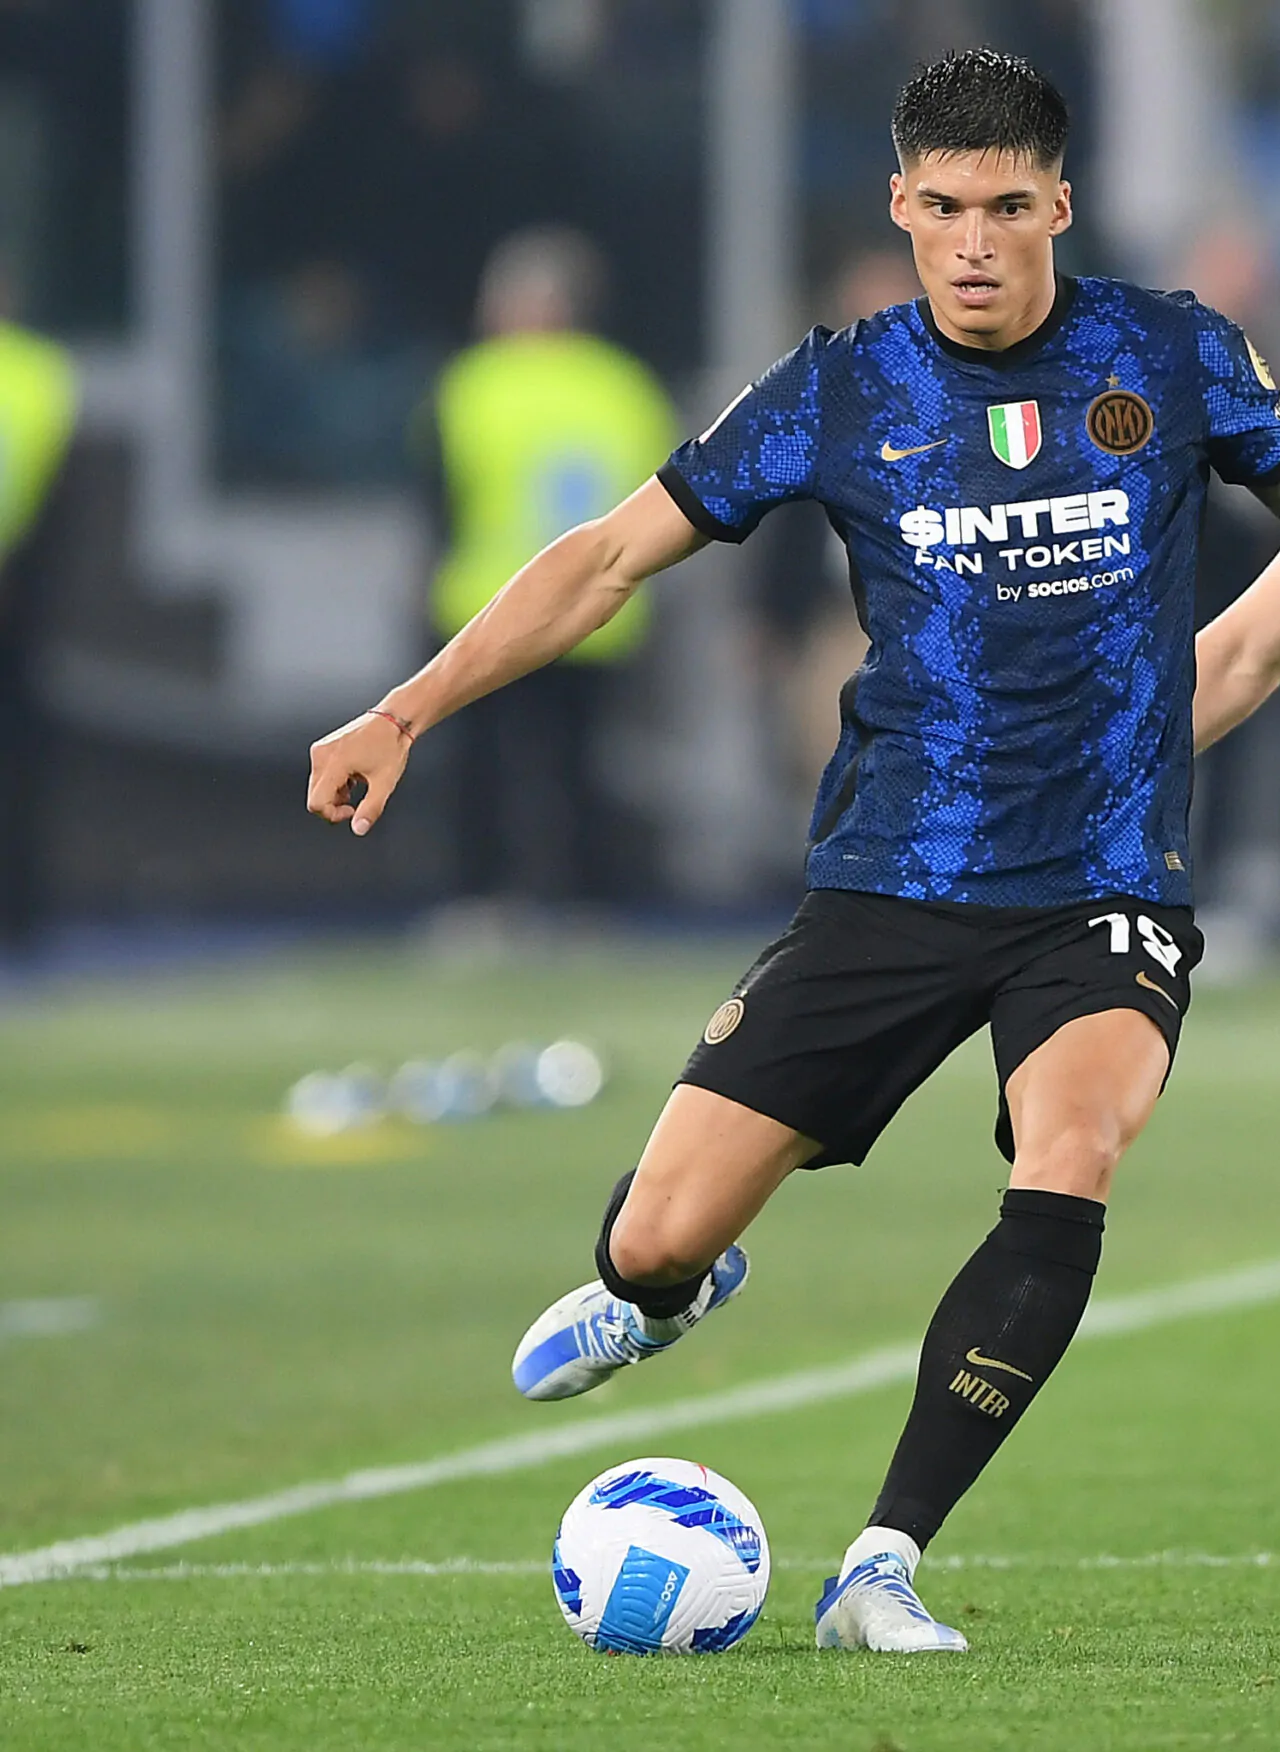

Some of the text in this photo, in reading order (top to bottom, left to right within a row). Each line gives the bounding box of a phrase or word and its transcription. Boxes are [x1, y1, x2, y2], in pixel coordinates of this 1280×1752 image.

[999, 533, 1131, 571] TOKEN
[996, 566, 1134, 603] by socios.com
[948, 1368, 1011, 1419] INTER
